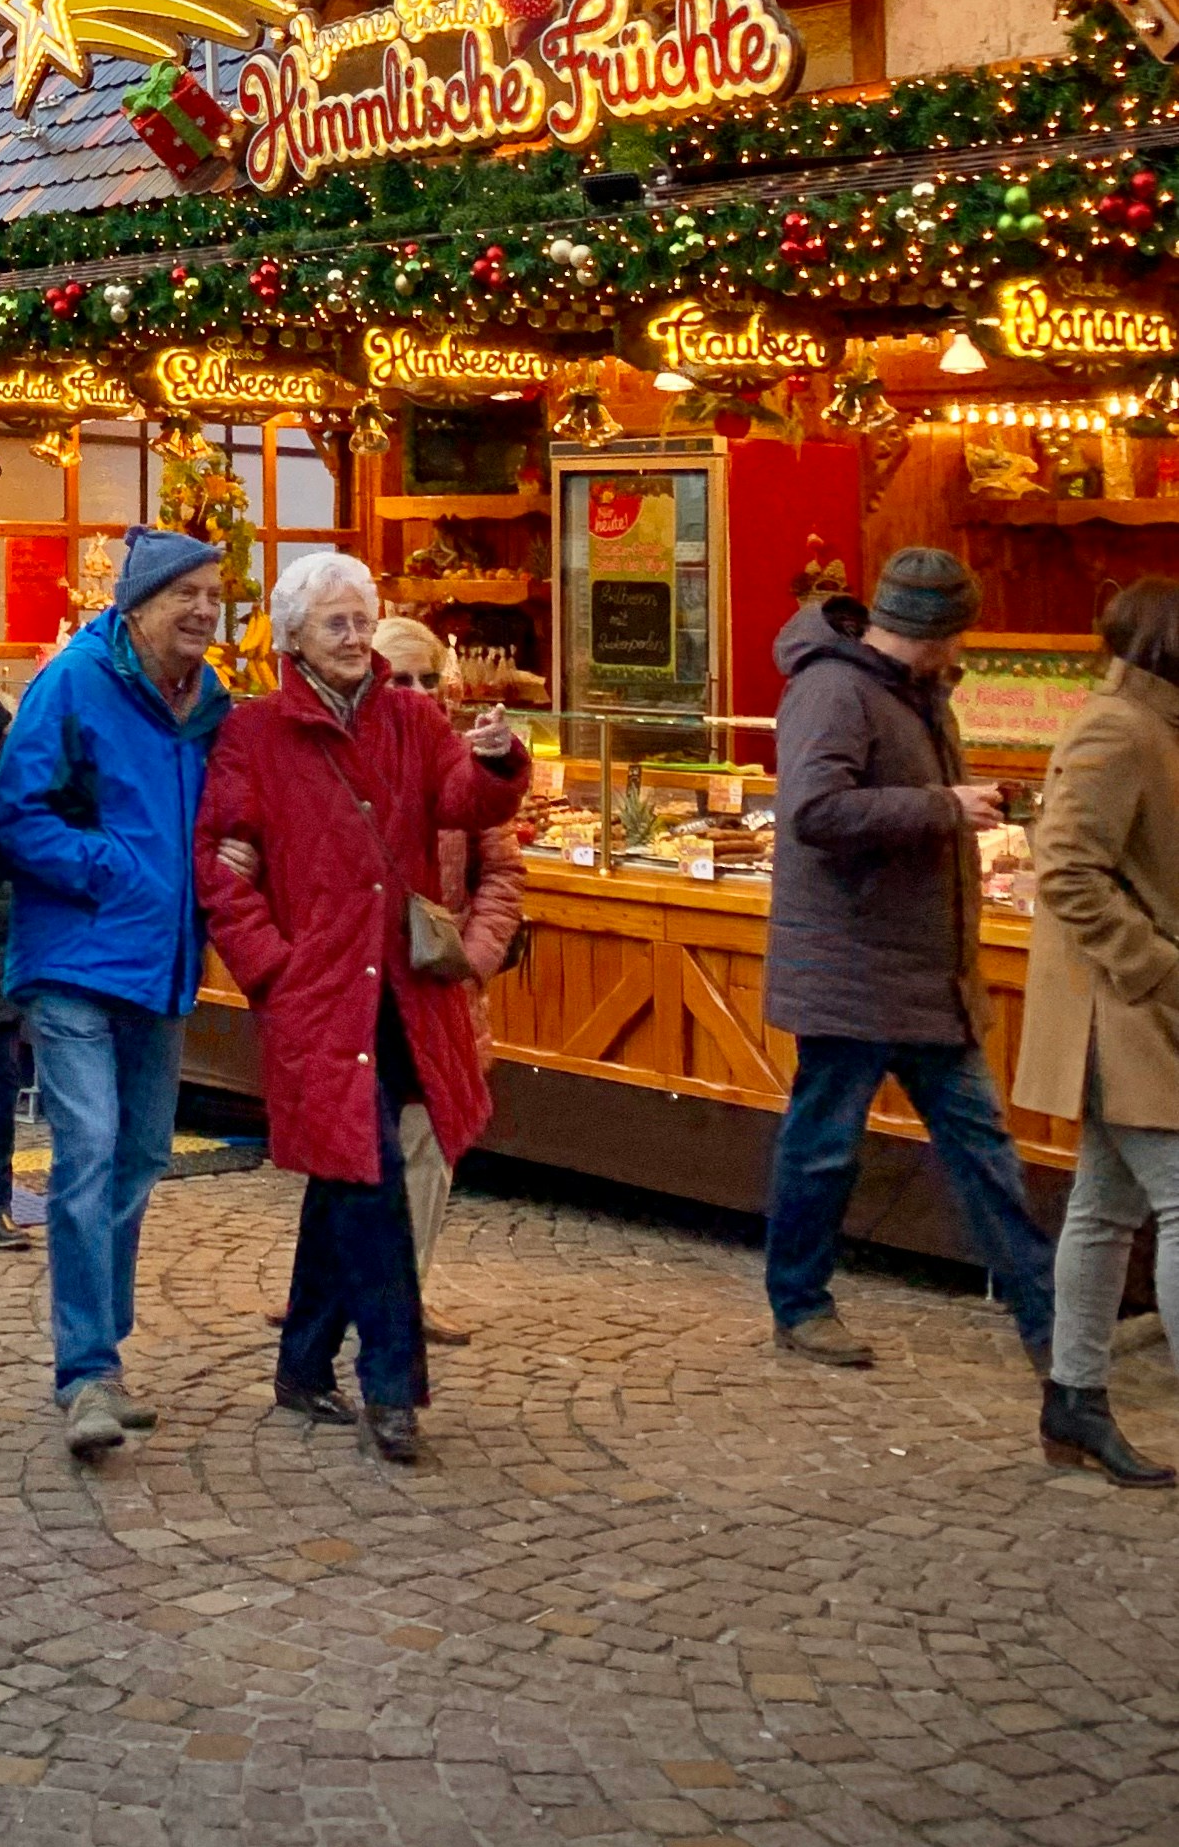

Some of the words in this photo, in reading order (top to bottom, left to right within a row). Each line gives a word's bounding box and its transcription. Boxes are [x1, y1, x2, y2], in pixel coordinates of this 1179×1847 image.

[290, 11, 400, 81] Yvonne
[238, 28, 538, 190] Himmlische
[649, 302, 825, 367] Trauben
[1000, 278, 1176, 357] Bananen
[156, 348, 323, 405] Erdbeeren
[364, 328, 550, 386] Himbeeren
